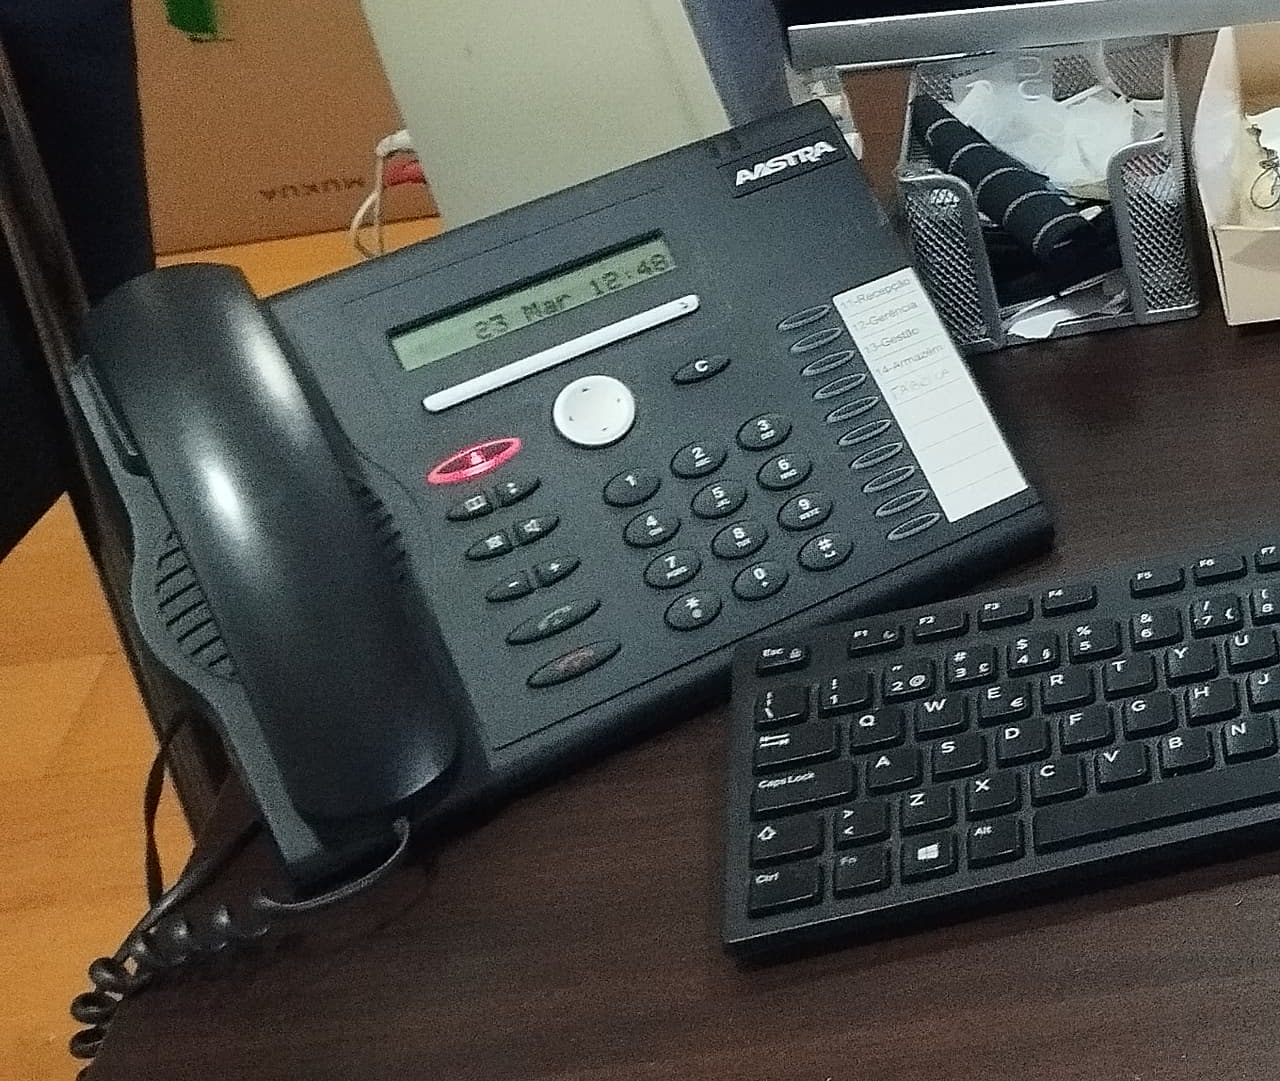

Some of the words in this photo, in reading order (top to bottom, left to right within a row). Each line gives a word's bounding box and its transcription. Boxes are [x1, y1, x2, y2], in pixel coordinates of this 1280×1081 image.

[474, 313, 509, 341] 23
[521, 293, 572, 323] Mar
[694, 360, 710, 373] C
[625, 474, 638, 487] 1
[1260, 545, 1276, 555] F7
[1199, 559, 1215, 568] F6
[753, 568, 766, 580] 0
[1136, 571, 1153, 581] F5
[1048, 589, 1063, 598] F4
[984, 602, 1000, 610] F3
[1262, 603, 1273, 613] 8
[918, 616, 936, 625] F2
[1202, 615, 1213, 625] 7
[853, 629, 869, 638] F1
[1141, 628, 1152, 638] 6
[1080, 641, 1091, 651] 5
[1234, 634, 1249, 647] U
[762, 647, 785, 658] Esc
[1174, 647, 1188, 659] Y
[1017, 654, 1029, 664] 4
[1112, 660, 1126, 672] T
[955, 668, 966, 678] 3
[1258, 673, 1270, 685] J
[1050, 674, 1064, 686] R
[892, 681, 903, 692] 2
[1194, 686, 1210, 699] H
[987, 686, 1001, 700] E
[830, 694, 839, 705] 1
[924, 698, 947, 713] W
[1131, 700, 1146, 712] G
[859, 715, 876, 727] Q
[1069, 713, 1083, 726] F
[1004, 727, 1020, 740] D
[1231, 722, 1247, 736] N
[941, 741, 955, 754] S
[1169, 736, 1183, 749] B
[875, 756, 891, 768] A
[1103, 750, 1119, 763] V
[1040, 764, 1055, 777] C
[975, 778, 991, 792] X
[910, 793, 925, 806] Z
[973, 825, 993, 837] Alt
[755, 872, 780, 884] Ctrl
